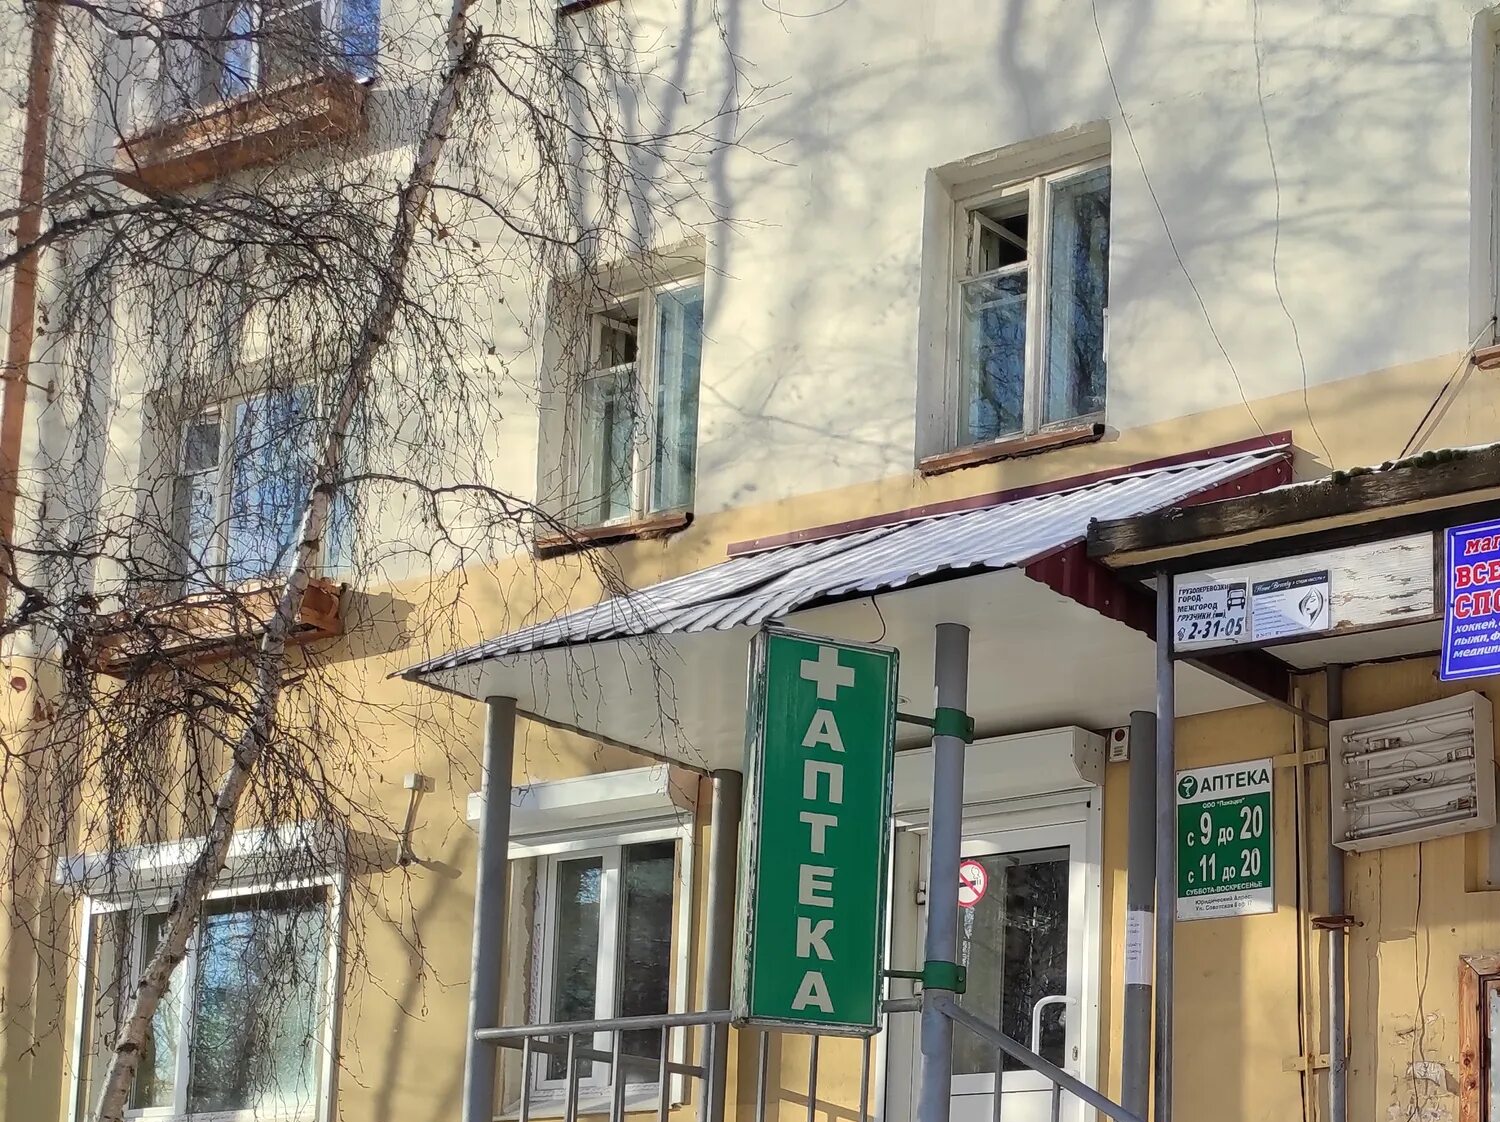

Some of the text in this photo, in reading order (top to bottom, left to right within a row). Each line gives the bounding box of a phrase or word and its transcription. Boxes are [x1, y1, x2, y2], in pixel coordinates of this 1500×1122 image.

[1179, 584, 1229, 595] ГРУЗОПЕРЕВОЗКИ
[1177, 602, 1218, 612] МЕЖГОРОД
[1188, 617, 1244, 640] 2-31-05
[1200, 769, 1270, 793] АПТЕКА
[1187, 805, 1263, 846] с 9 до 20
[791, 708, 846, 1013] АПТЕКА
[1188, 848, 1261, 883] с 11 до 20
